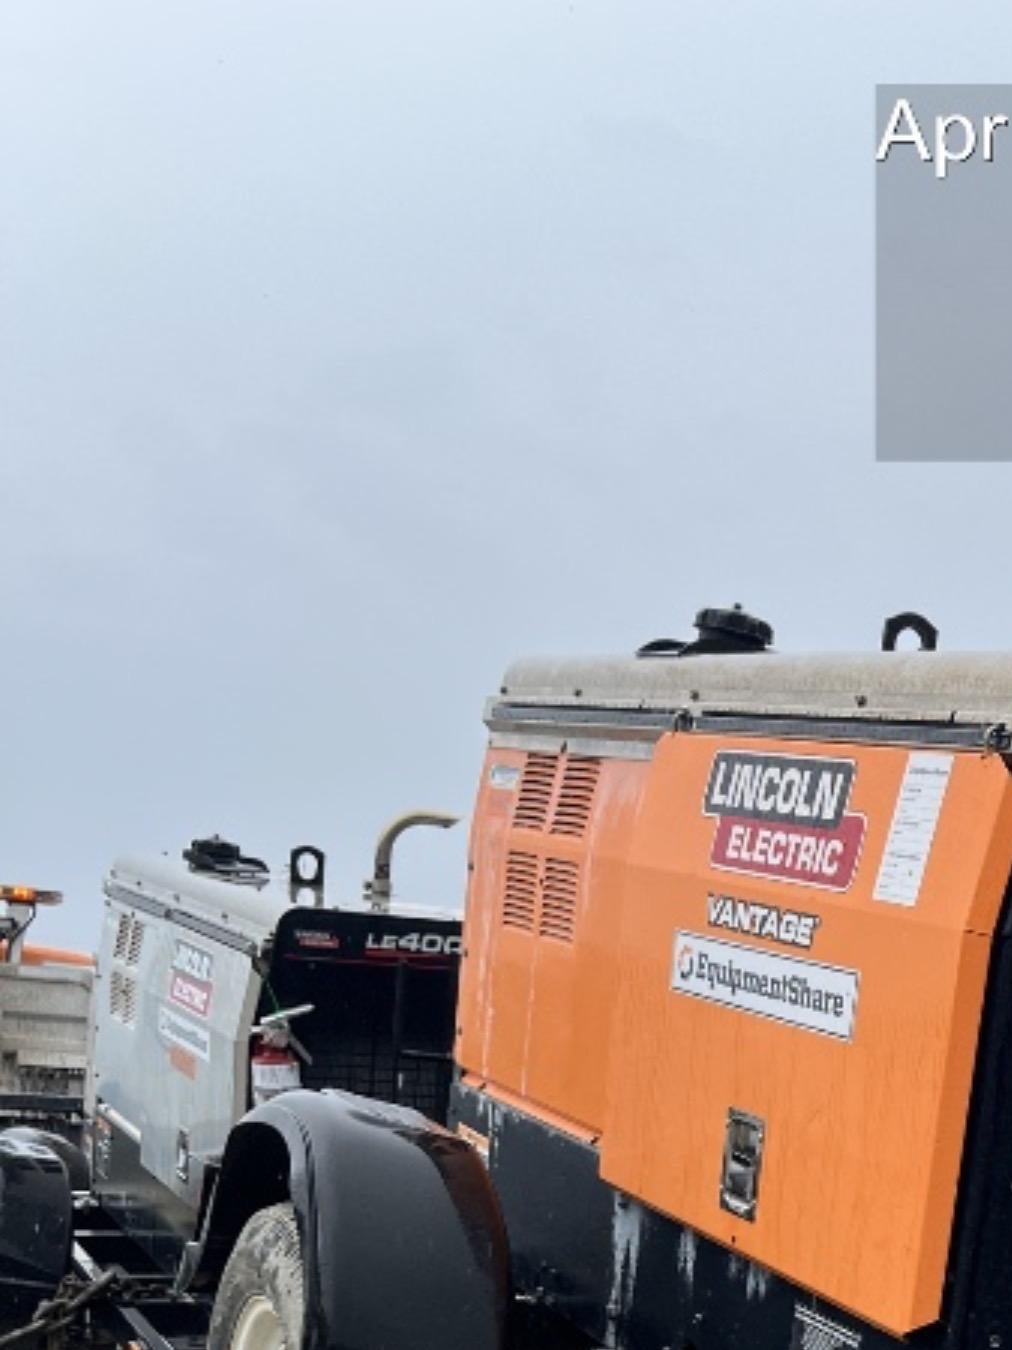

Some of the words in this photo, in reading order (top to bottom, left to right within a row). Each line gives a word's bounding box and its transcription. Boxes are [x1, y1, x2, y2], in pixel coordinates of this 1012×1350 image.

[709, 761, 845, 821] LINCOLN
[725, 825, 846, 875] ELECTRIC
[707, 893, 819, 947] VANTAGE
[694, 952, 845, 1018] EquipmentShare
